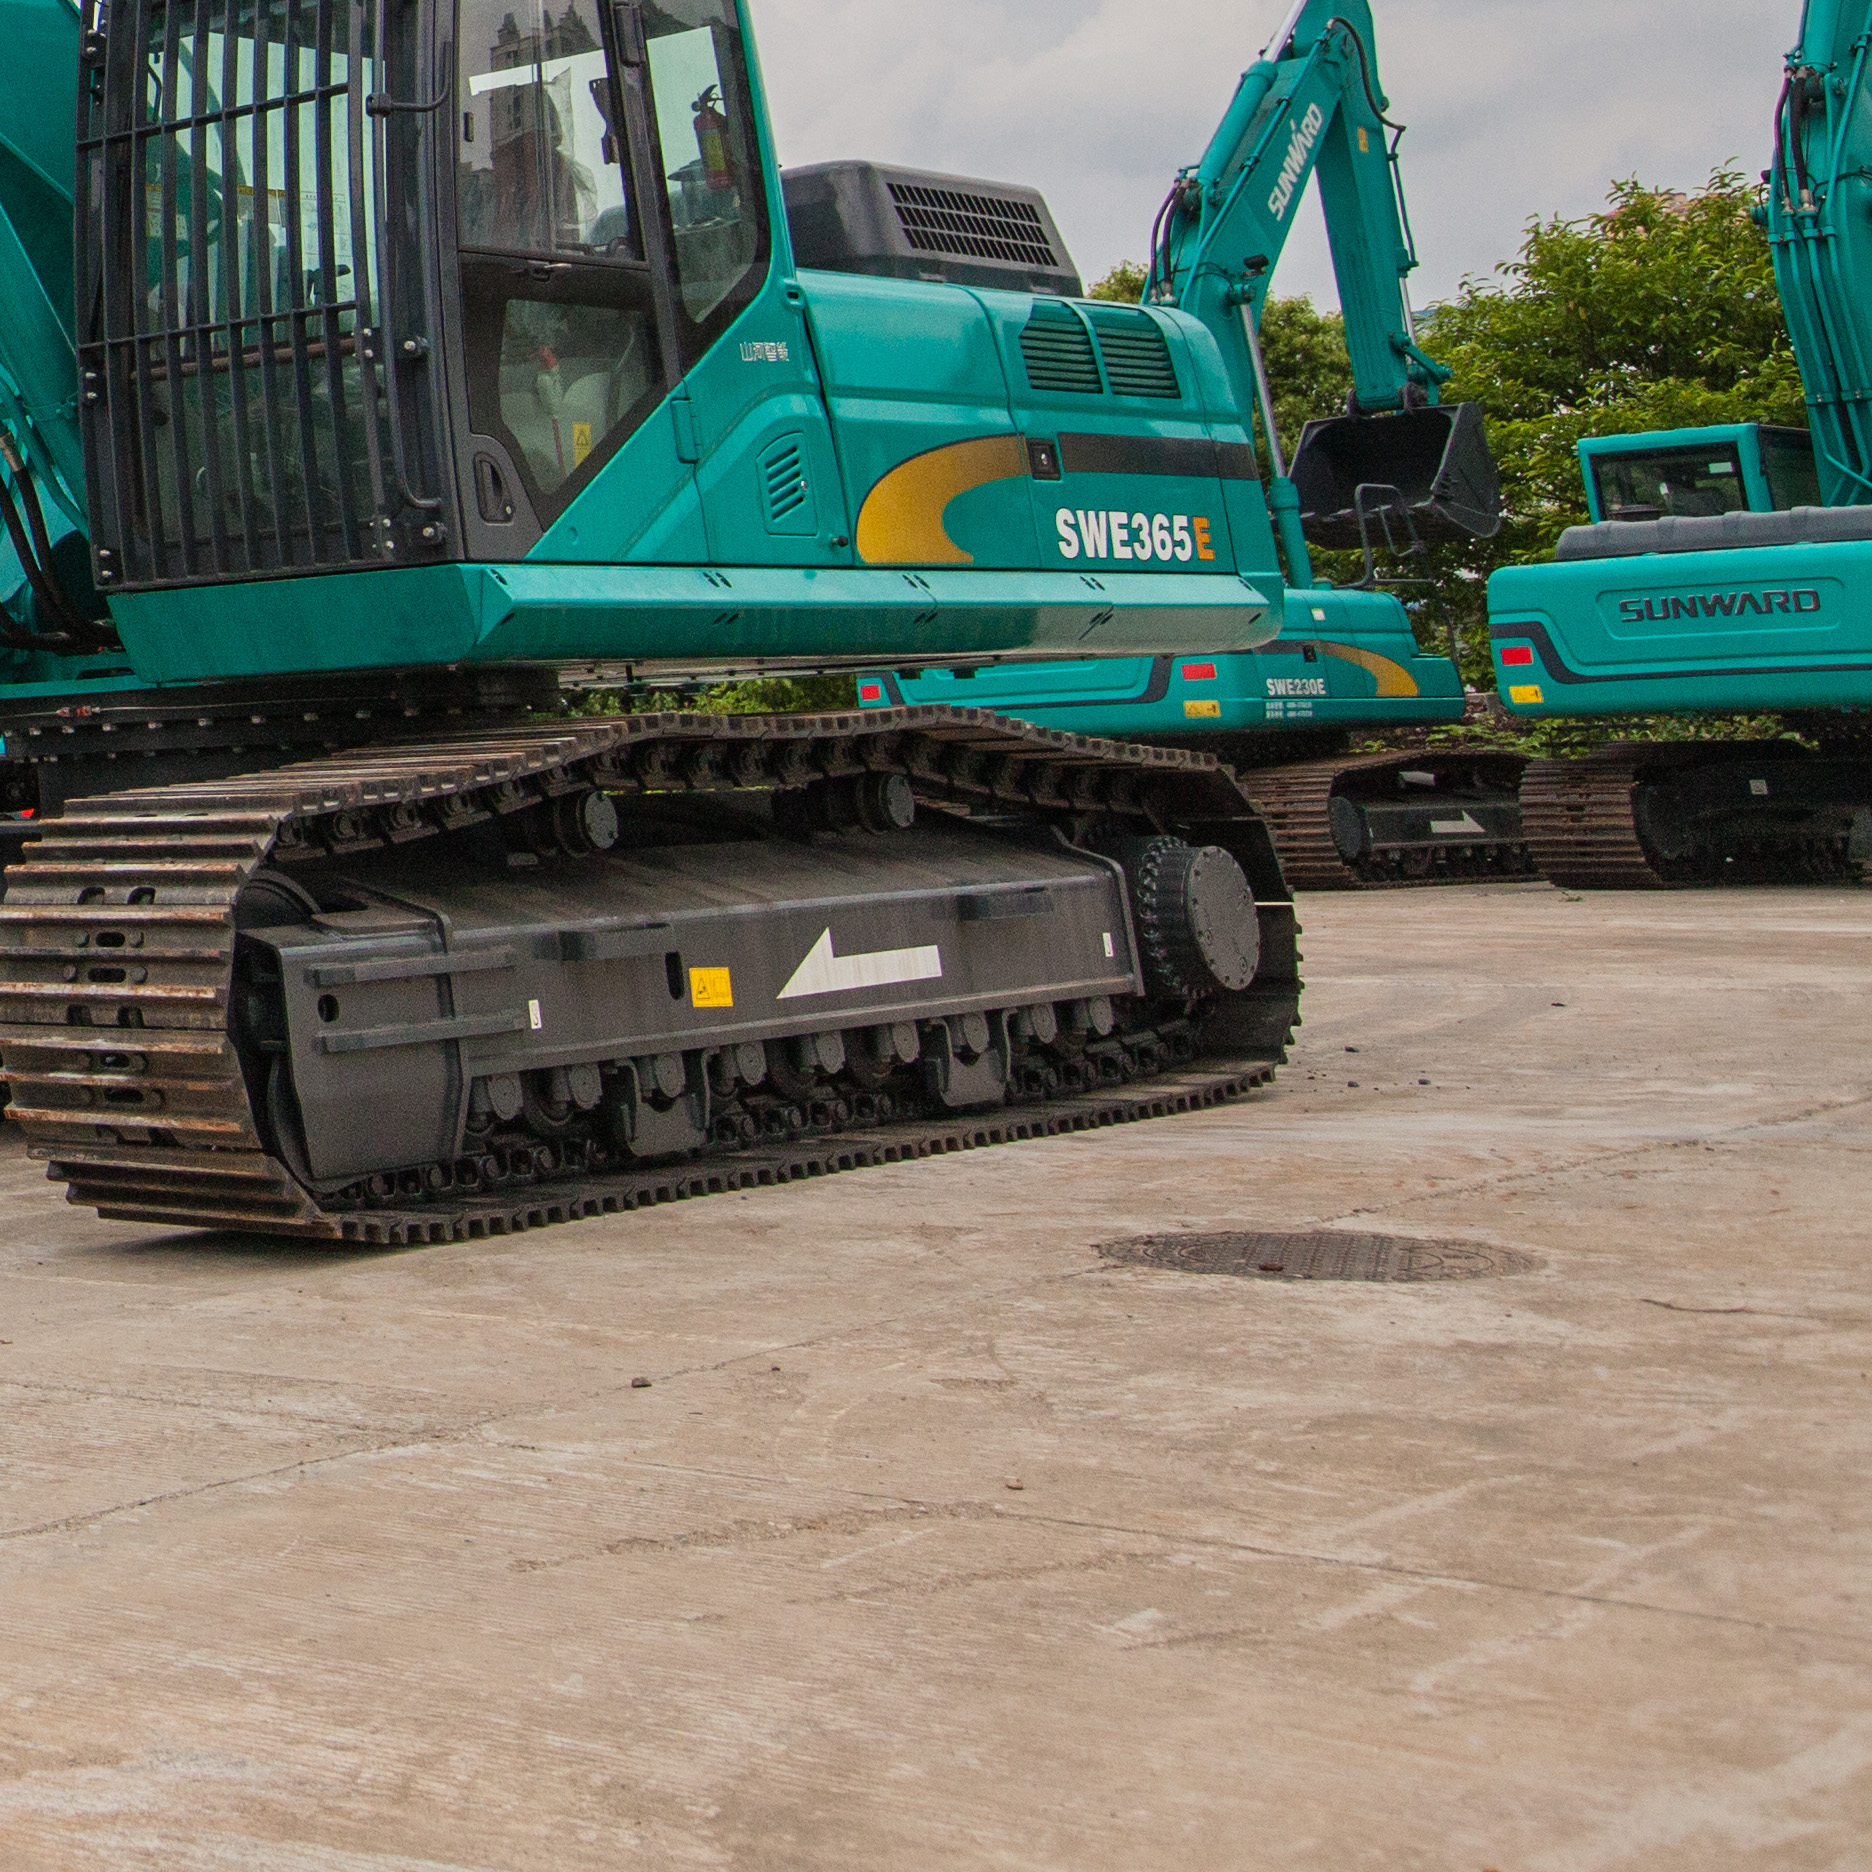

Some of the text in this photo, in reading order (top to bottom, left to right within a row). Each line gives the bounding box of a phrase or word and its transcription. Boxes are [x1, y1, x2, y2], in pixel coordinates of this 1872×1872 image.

[1268, 102, 1324, 222] SUNWARD
[1056, 508, 1215, 561] SWE365E
[1619, 588, 1821, 622] SUNWARD
[1266, 677, 1326, 696] SWE230E
